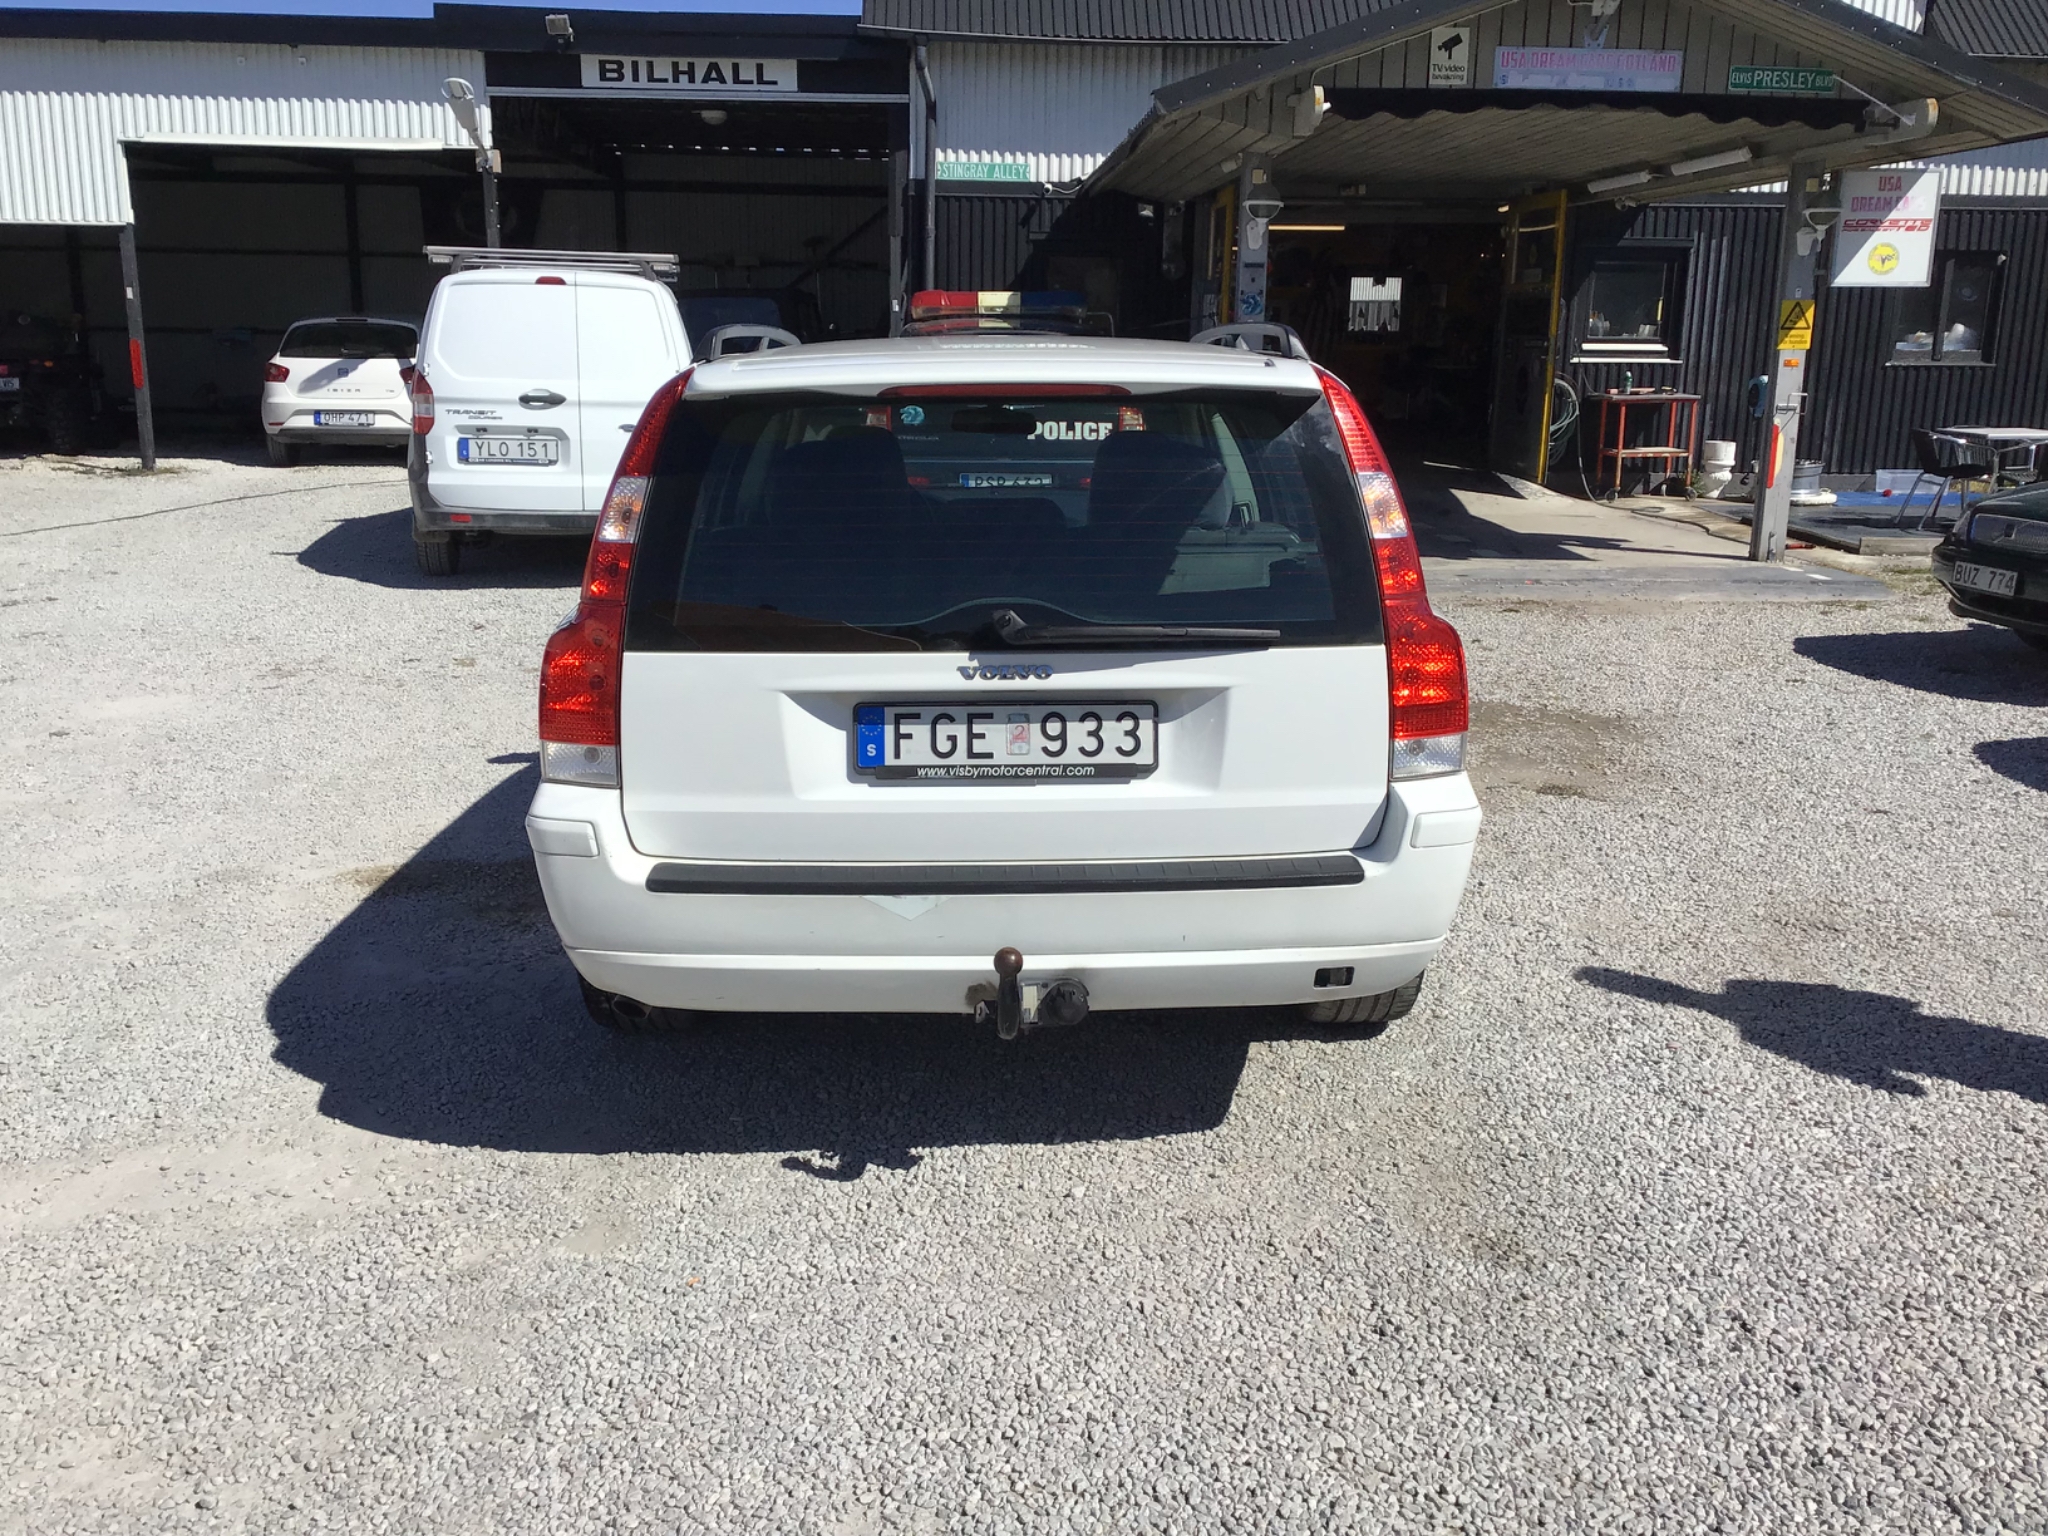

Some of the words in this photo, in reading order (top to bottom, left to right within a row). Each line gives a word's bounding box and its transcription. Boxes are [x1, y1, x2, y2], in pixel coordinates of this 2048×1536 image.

[1501, 51, 1527, 69] USA
[598, 58, 779, 86] BILHALL
[1732, 72, 1753, 84] ELVIS
[1753, 70, 1816, 89] PRESLEY
[943, 163, 990, 179] STINGRAY
[993, 165, 1026, 179] ALLEY
[1878, 175, 1903, 192] USA
[1851, 196, 1893, 213] DREAM
[323, 412, 345, 423] OHP
[348, 412, 369, 423] 471
[475, 441, 510, 457] YLO
[517, 442, 548, 458] 151
[1954, 564, 1980, 586] BUZ
[1988, 570, 2015, 593] 774
[956, 664, 1054, 681] VOLVO
[894, 712, 995, 760] FGE
[1039, 711, 1142, 758] 933
[866, 743, 877, 757] S
[916, 764, 1095, 780] www.visbymotorcentral.com
